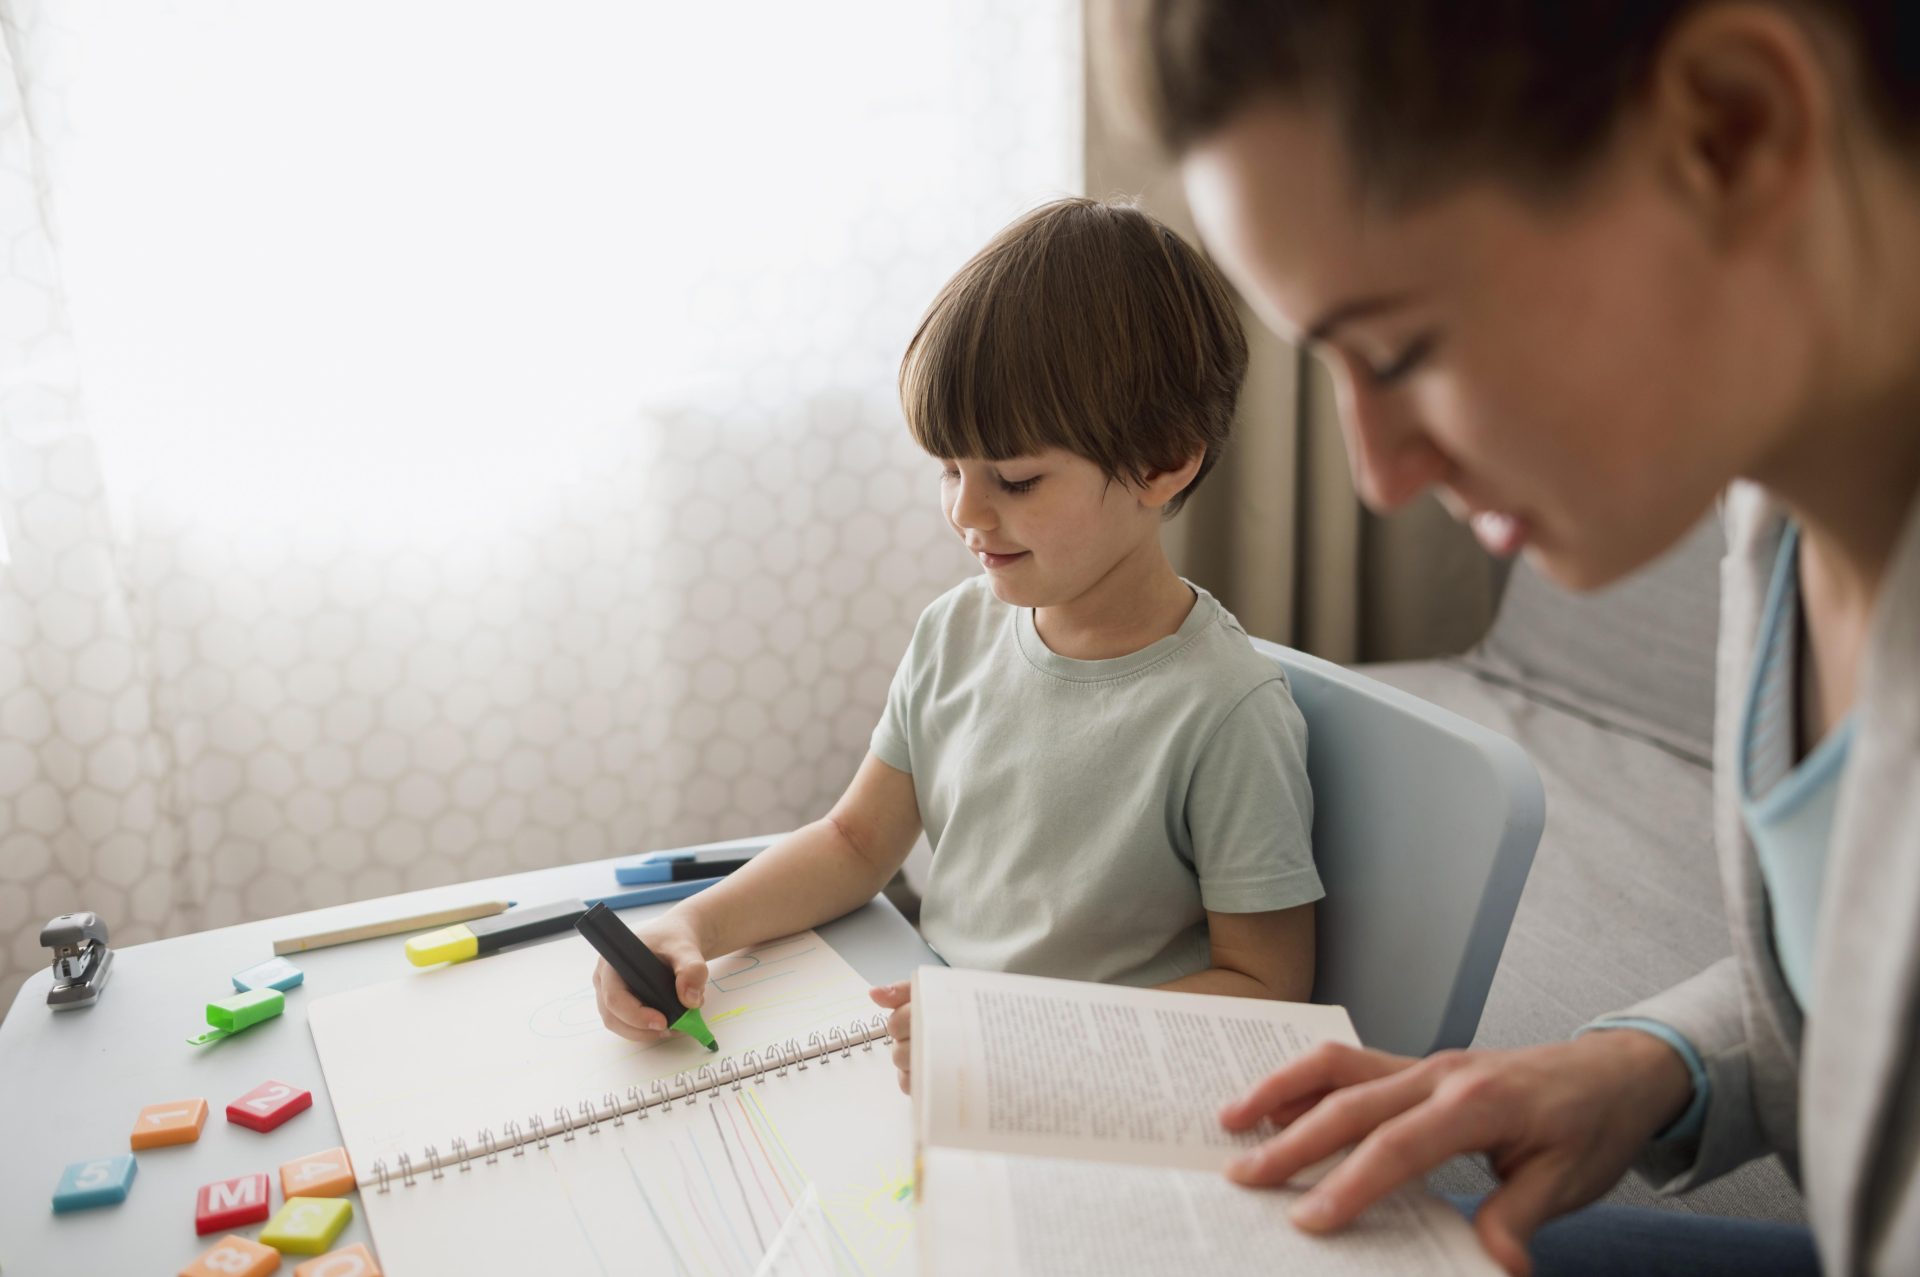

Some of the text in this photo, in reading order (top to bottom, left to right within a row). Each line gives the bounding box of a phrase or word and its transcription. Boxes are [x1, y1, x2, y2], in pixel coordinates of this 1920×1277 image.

[246, 1086, 290, 1110] 2
[146, 1110, 188, 1125] 1
[75, 1160, 112, 1190] 5
[208, 1175, 257, 1213] M
[205, 1247, 252, 1274] 8
